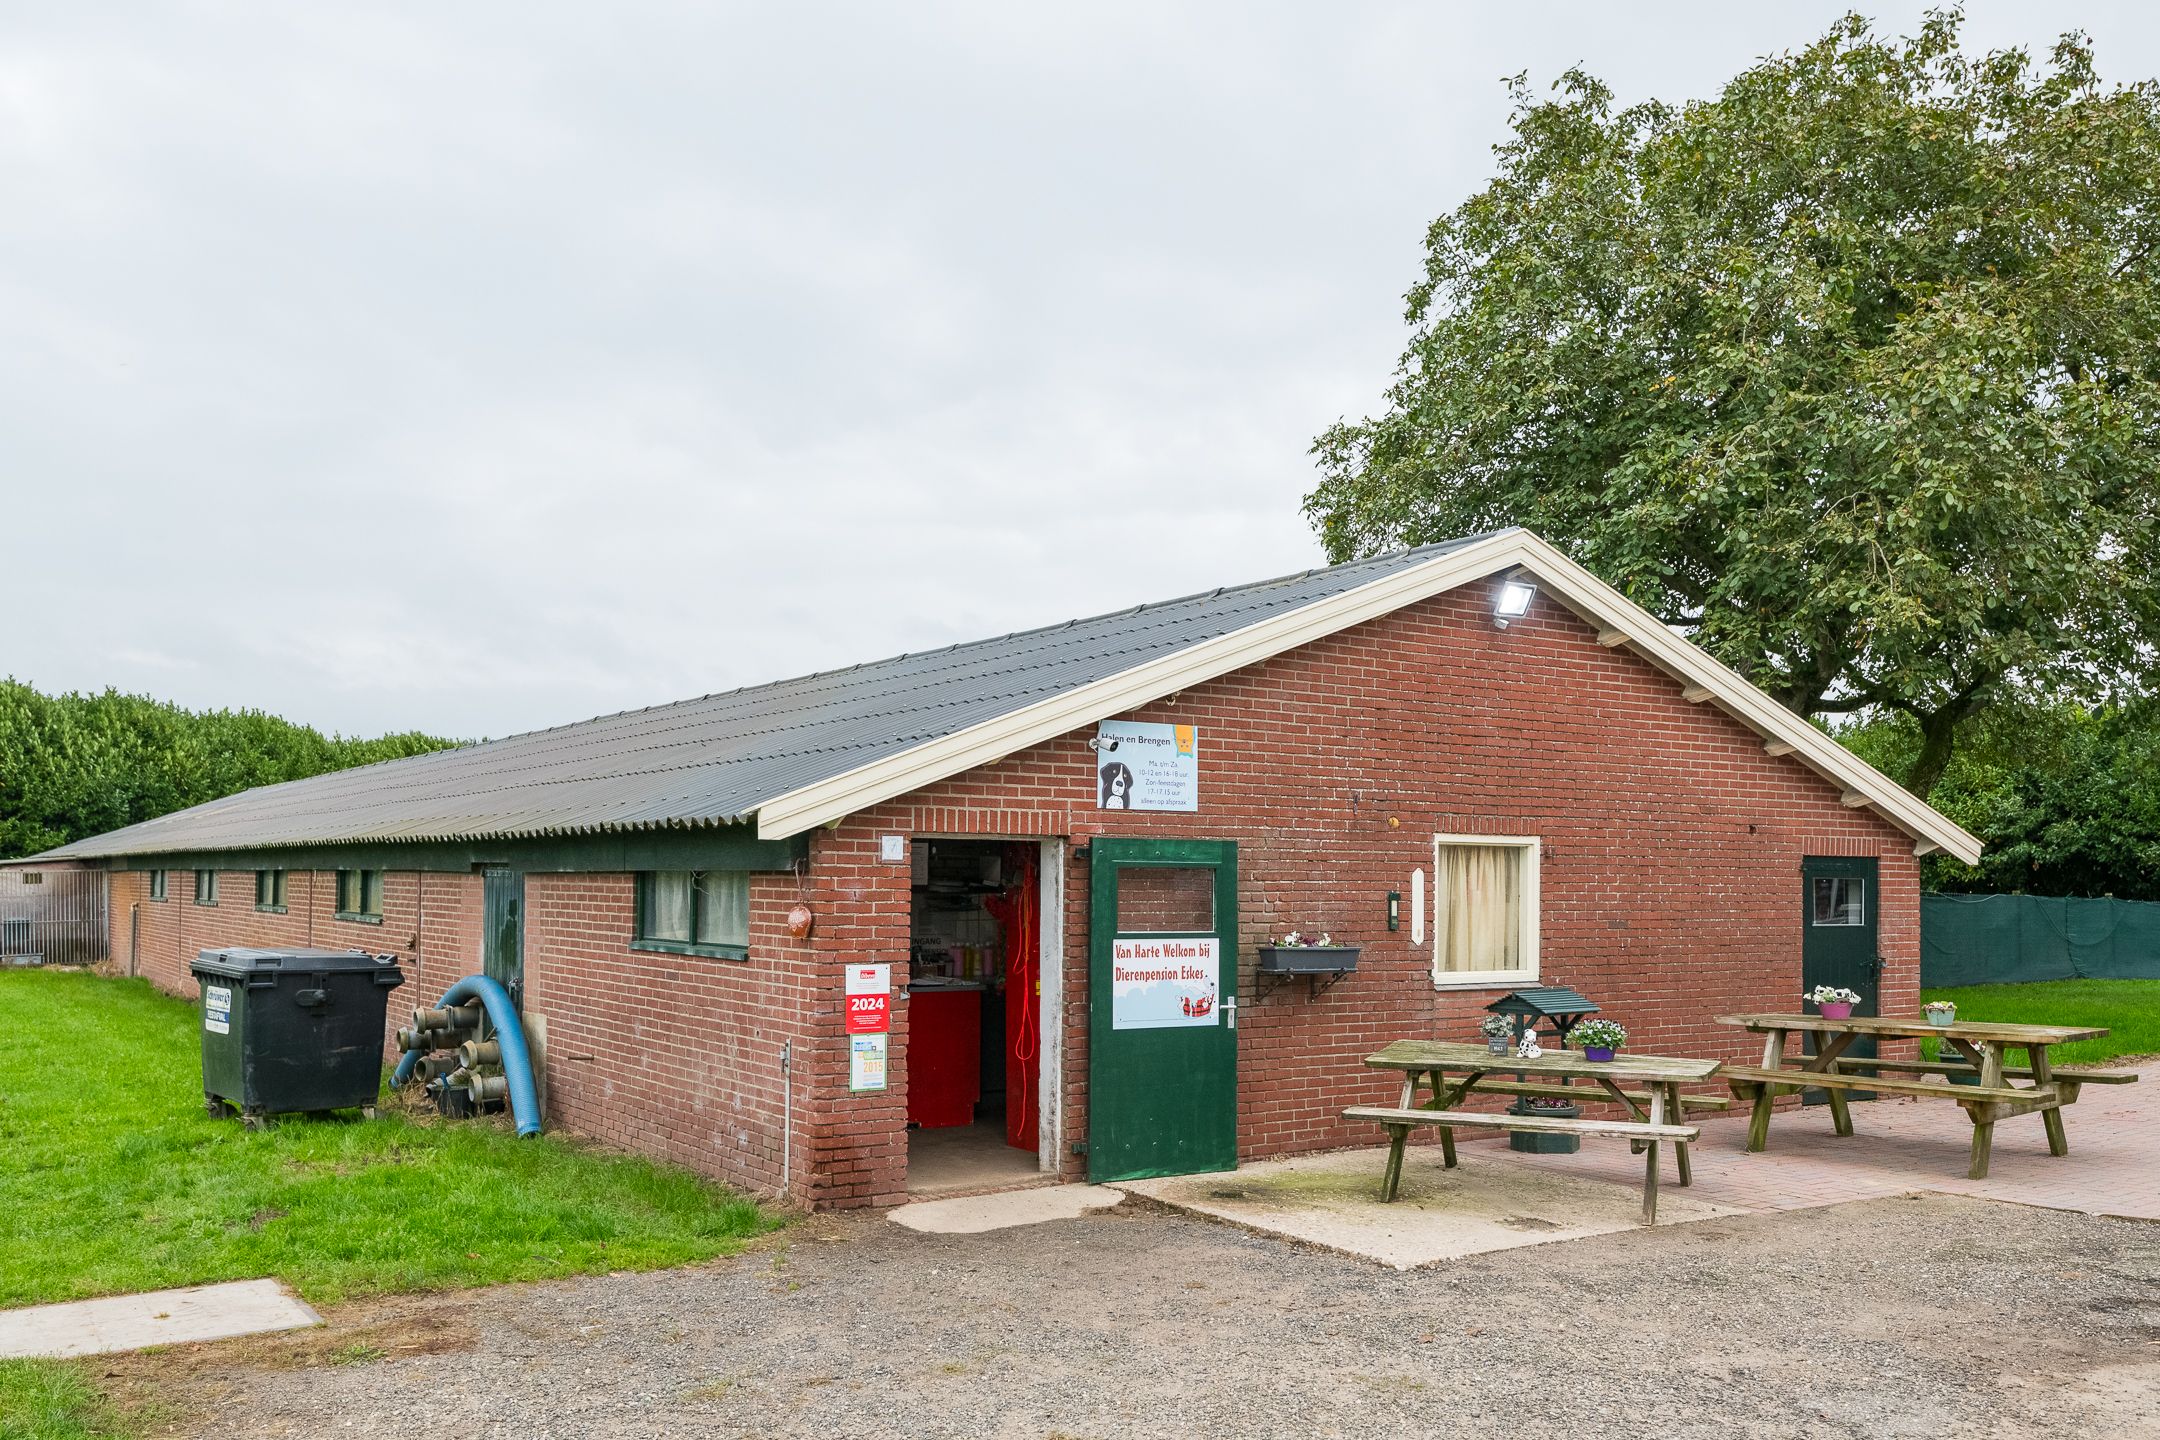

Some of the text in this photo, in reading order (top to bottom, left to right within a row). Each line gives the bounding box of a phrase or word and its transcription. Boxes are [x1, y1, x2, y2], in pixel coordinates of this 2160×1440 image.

[1138, 736, 1171, 747] Brengen
[1165, 798, 1187, 806] afspraak
[1115, 943, 1210, 959] Van Harte Welkom bij
[1115, 965, 1204, 982] Dierenpension Eskes
[851, 997, 885, 1011] 2024
[863, 1061, 883, 1073] 2015
